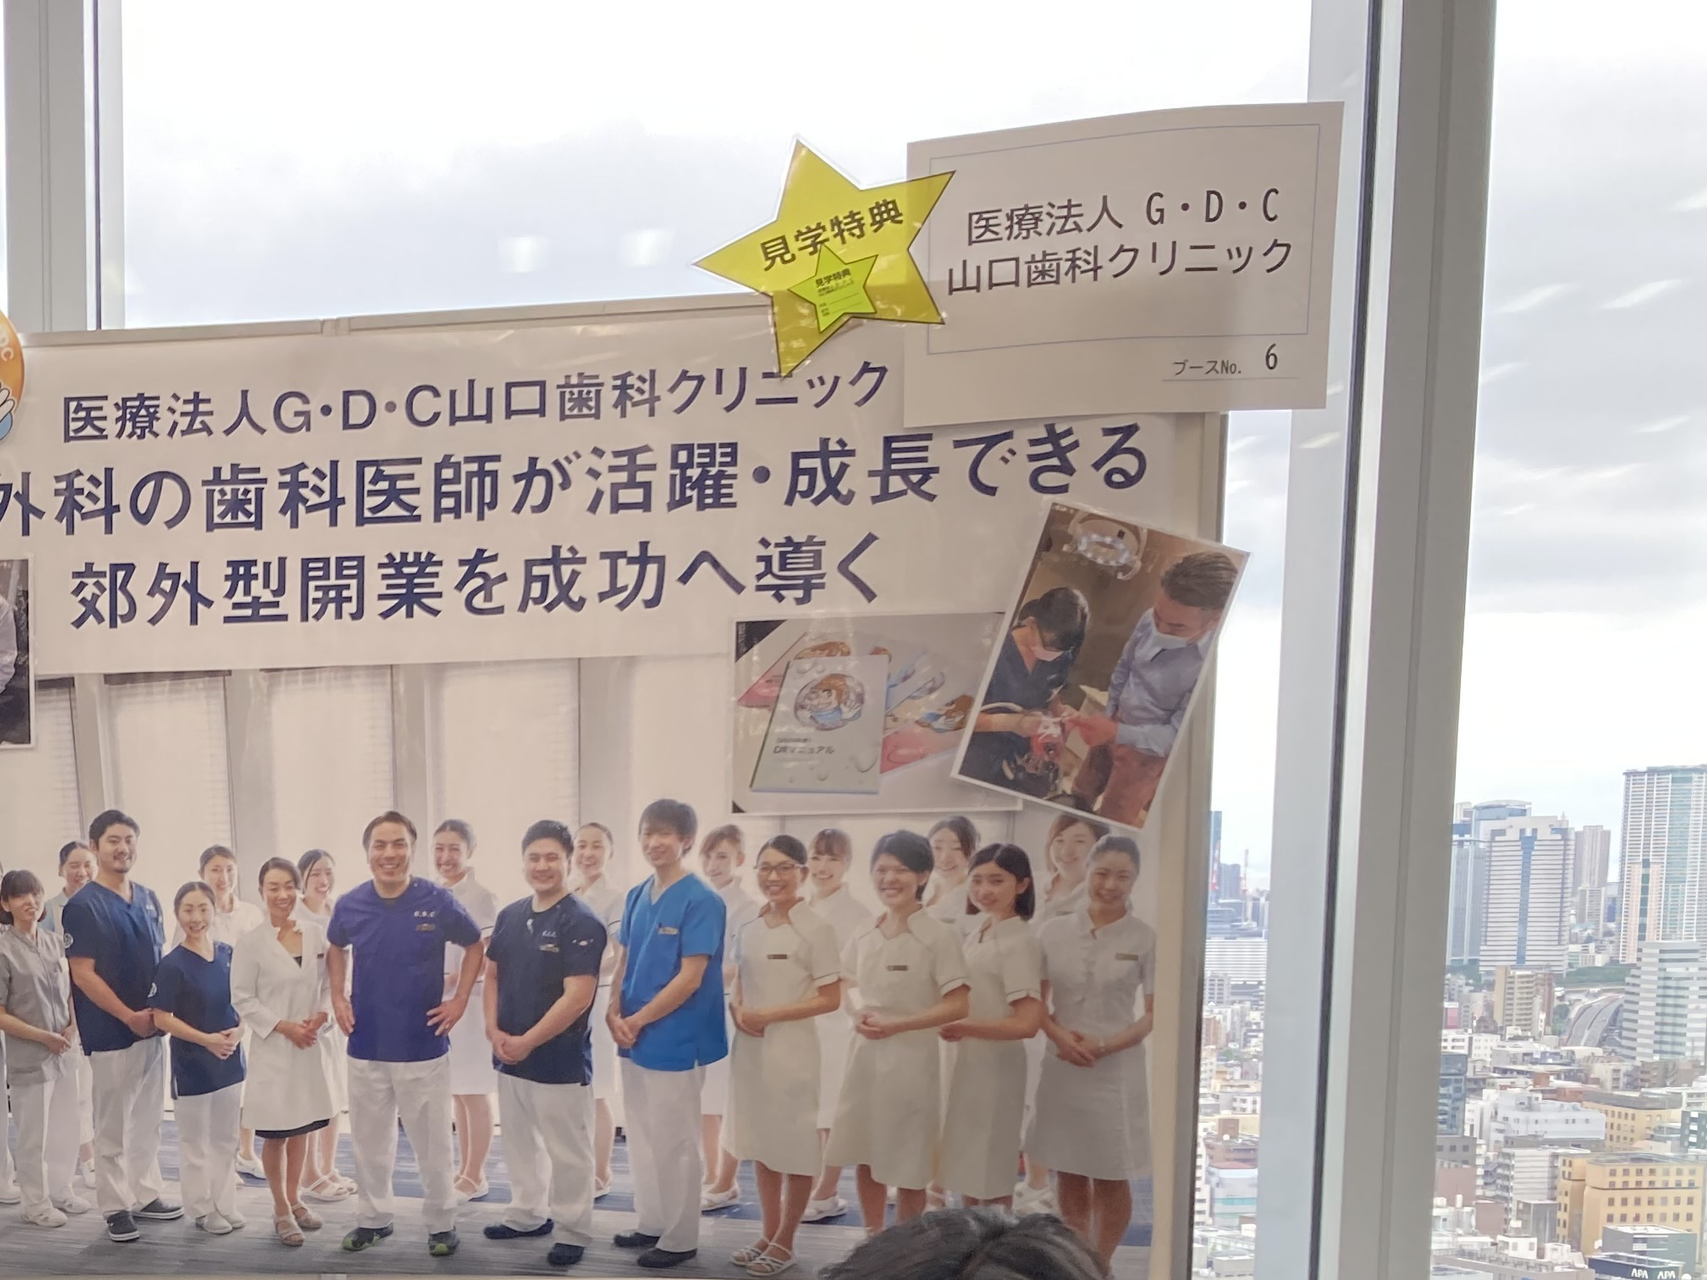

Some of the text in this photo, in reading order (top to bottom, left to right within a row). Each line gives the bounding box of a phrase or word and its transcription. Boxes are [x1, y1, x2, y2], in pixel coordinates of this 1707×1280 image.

[759, 197, 905, 271] 見学特典
[966, 195, 1124, 247] 医療法人
[946, 237, 1293, 296] 山口歯科クリニック
[1172, 343, 1279, 376] ブースNo. 6
[62, 361, 890, 443] 医療法人G・D・C山口歯科クリニック
[70, 531, 881, 630] 郊外型開業を成功へ導く
[1631, 1268, 1649, 1280] APA
[1657, 1270, 1676, 1280] APA
